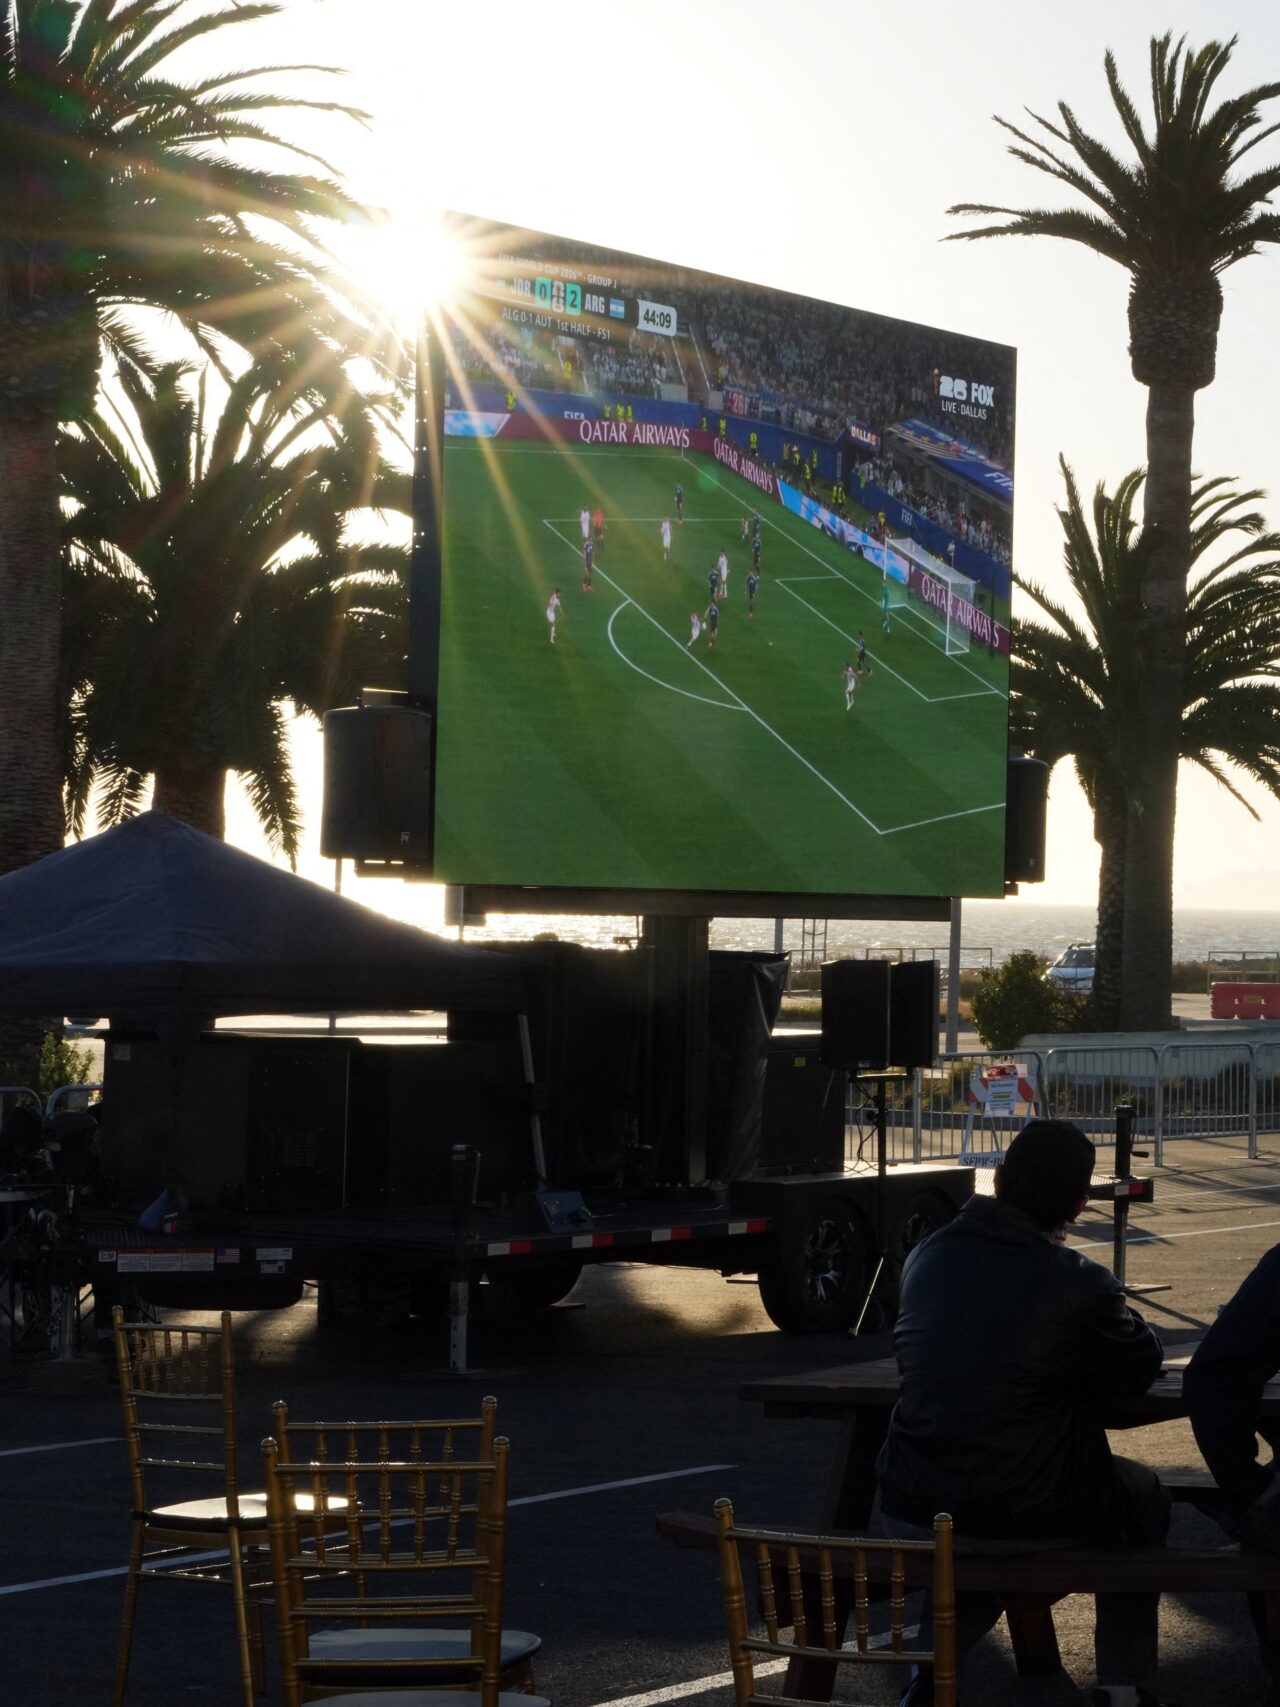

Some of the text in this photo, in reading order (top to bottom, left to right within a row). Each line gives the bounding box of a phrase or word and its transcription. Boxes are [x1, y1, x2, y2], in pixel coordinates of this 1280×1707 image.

[545, 264, 560, 276] CUP
[587, 274, 612, 287] GROUP
[511, 278, 547, 301] JOR 0
[569, 289, 605, 314] 2 ARG
[502, 307, 519, 322] ALG
[520, 311, 533, 324] 0-1
[535, 314, 552, 329] AUT
[556, 319, 568, 332] 1st
[570, 323, 591, 336] HALF
[598, 328, 611, 342] FS1
[643, 308, 672, 329] 44:09
[971, 382, 995, 407] FOX
[941, 400, 987, 420] LIVE DALLAS
[580, 420, 690, 448] QATAR AIRWAYS
[851, 426, 876, 446] DALLAS
[713, 438, 773, 495] QATAR AIRWAYS
